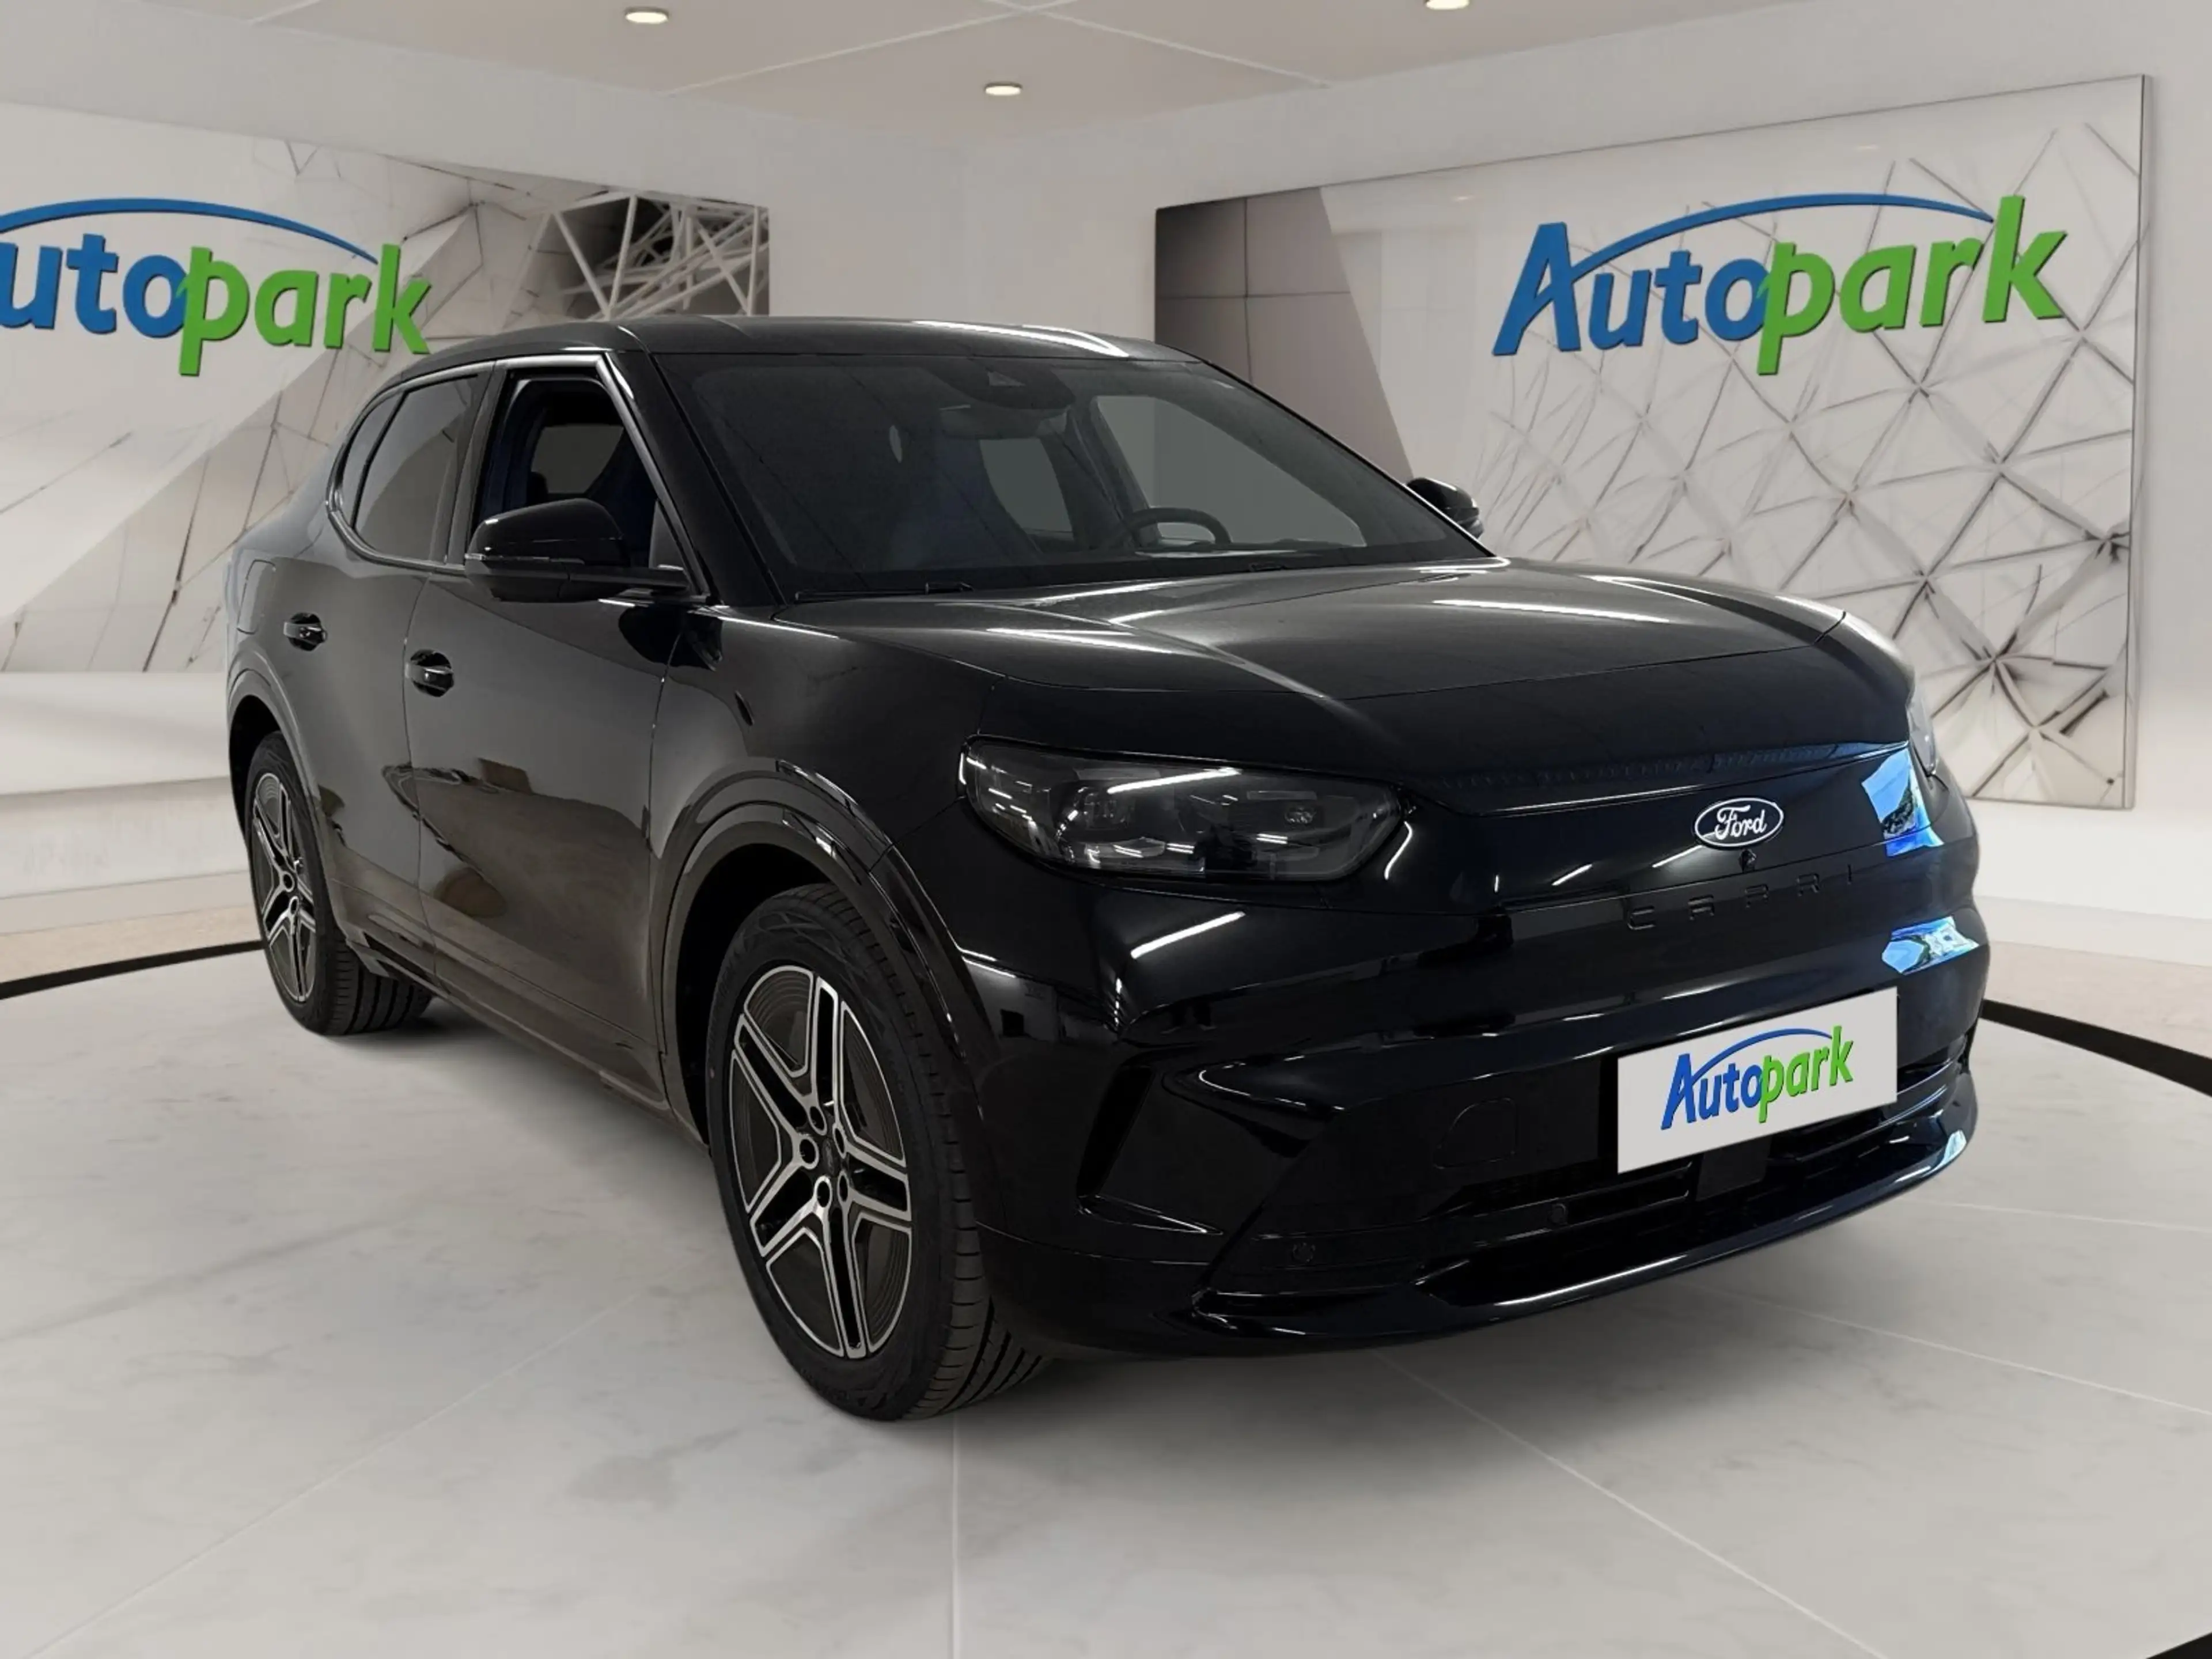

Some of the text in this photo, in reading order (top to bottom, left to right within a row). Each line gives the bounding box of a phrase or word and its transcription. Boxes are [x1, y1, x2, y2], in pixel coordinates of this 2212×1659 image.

[0, 233, 432, 377] utopark
[1491, 195, 2068, 376] Autopark
[1714, 804, 1768, 840] Ford
[1627, 863, 1853, 930] CAPRI
[1660, 1025, 1854, 1130] Autopark
